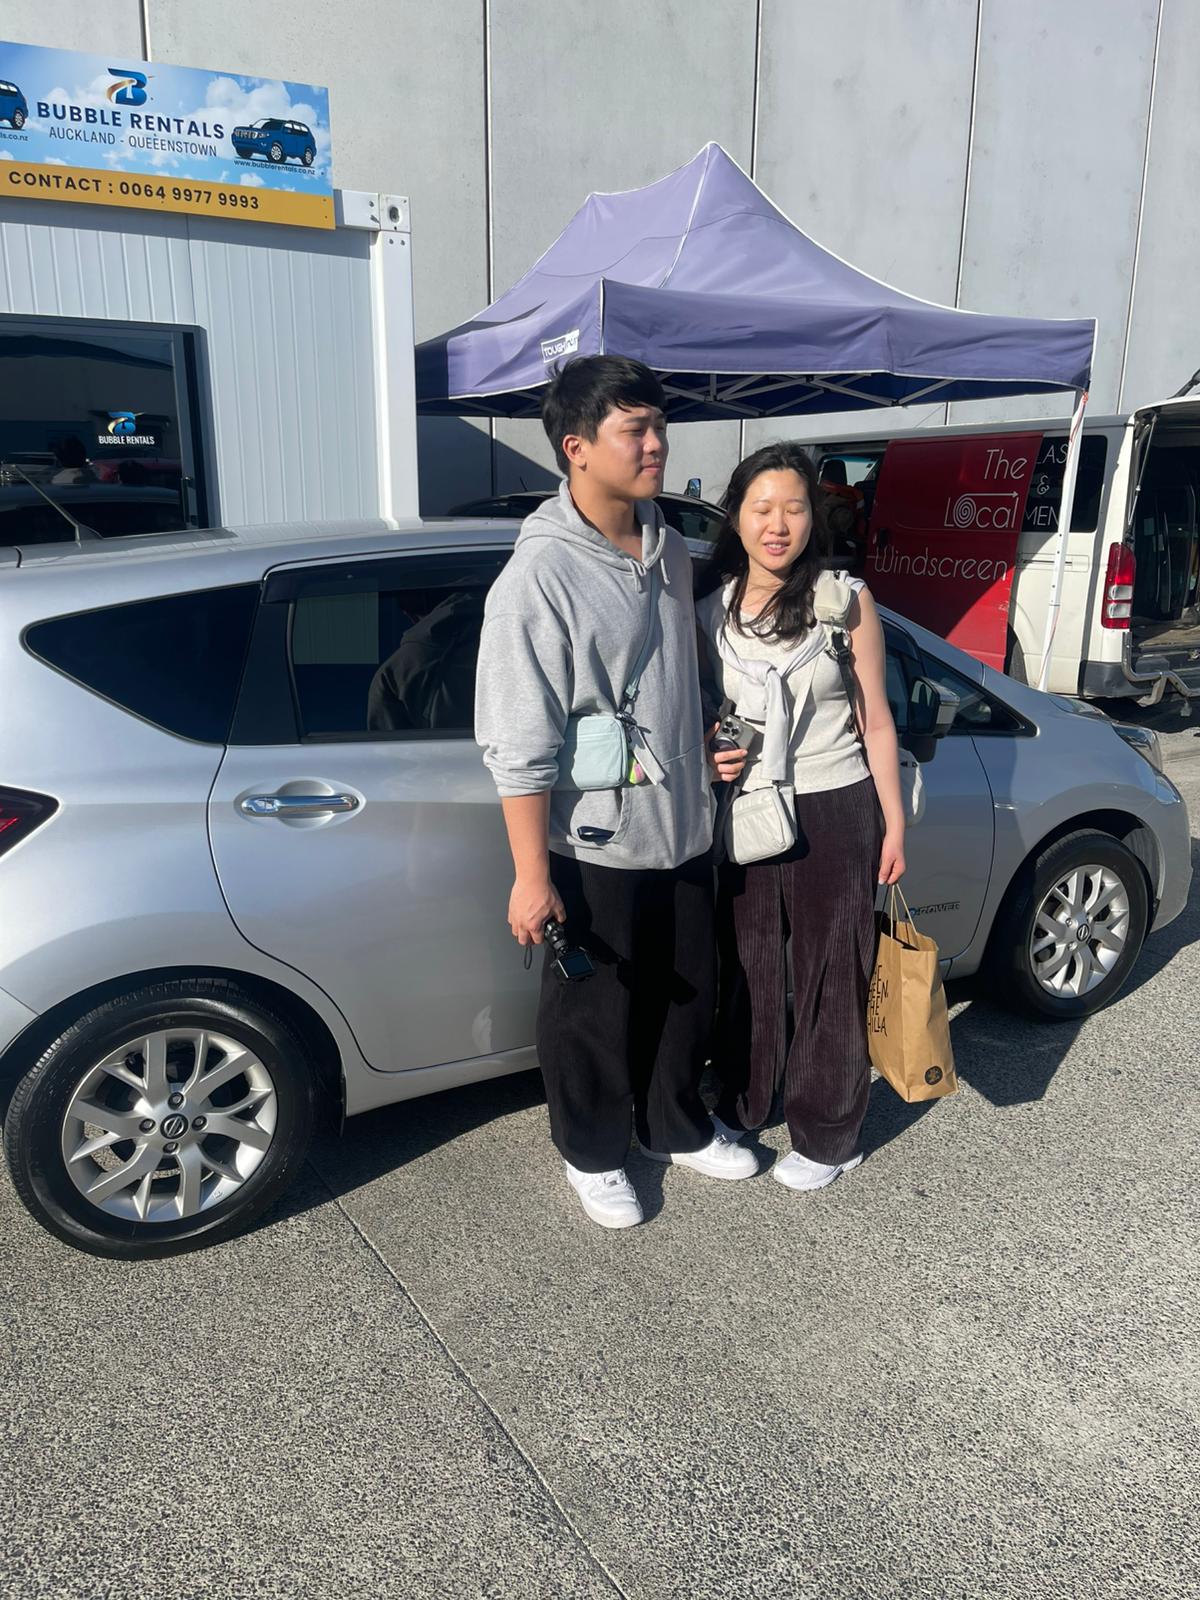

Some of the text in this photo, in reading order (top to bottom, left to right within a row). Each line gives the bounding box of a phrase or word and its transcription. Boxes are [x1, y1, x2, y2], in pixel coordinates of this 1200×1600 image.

[37, 101, 225, 139] BUBBLE RENTALS
[49, 126, 116, 146] AUCKLAND
[128, 135, 218, 157] QUEEENSTOWN
[9, 171, 102, 193] CONTACT
[119, 182, 166, 199] 0064
[172, 187, 212, 205] 9977
[218, 192, 259, 209] 9993
[98, 435, 155, 445] BUBBLE RENTALS
[984, 449, 1027, 480] The
[1037, 474, 1050, 495] &
[944, 494, 1019, 529] Local
[867, 547, 1008, 581] Windscreen
